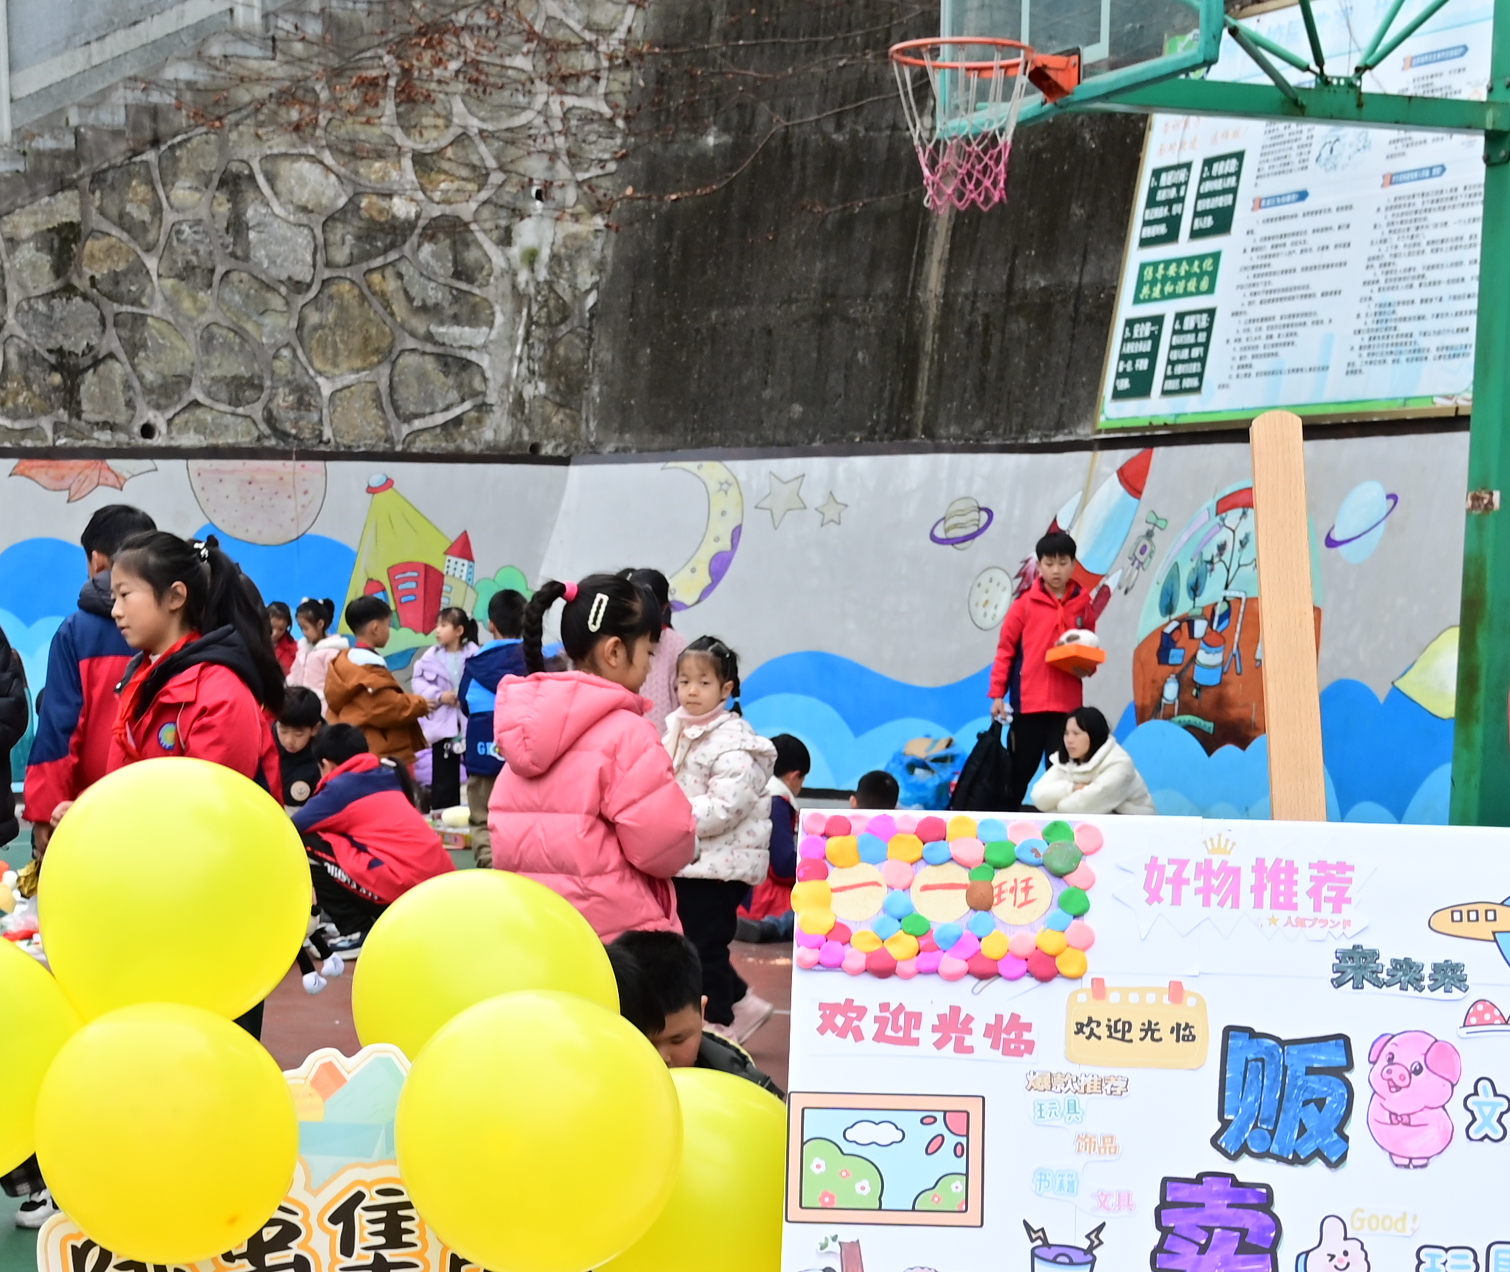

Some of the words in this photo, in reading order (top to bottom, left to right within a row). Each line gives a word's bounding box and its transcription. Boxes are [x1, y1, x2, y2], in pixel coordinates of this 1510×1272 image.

[1142, 855, 1356, 914] 好物推荐
[1330, 943, 1470, 994] 来来来
[817, 999, 1037, 1058] 欢迎光临
[1073, 1015, 1197, 1046] 欢迎光临
[1026, 1071, 1130, 1097] 爆款推荐
[1212, 1026, 1355, 1168] 贩
[1032, 1097, 1084, 1123] 玩具
[1075, 1132, 1120, 1156] 饰品
[1032, 1168, 1080, 1197] 书籍
[1091, 1189, 1137, 1213] 文具
